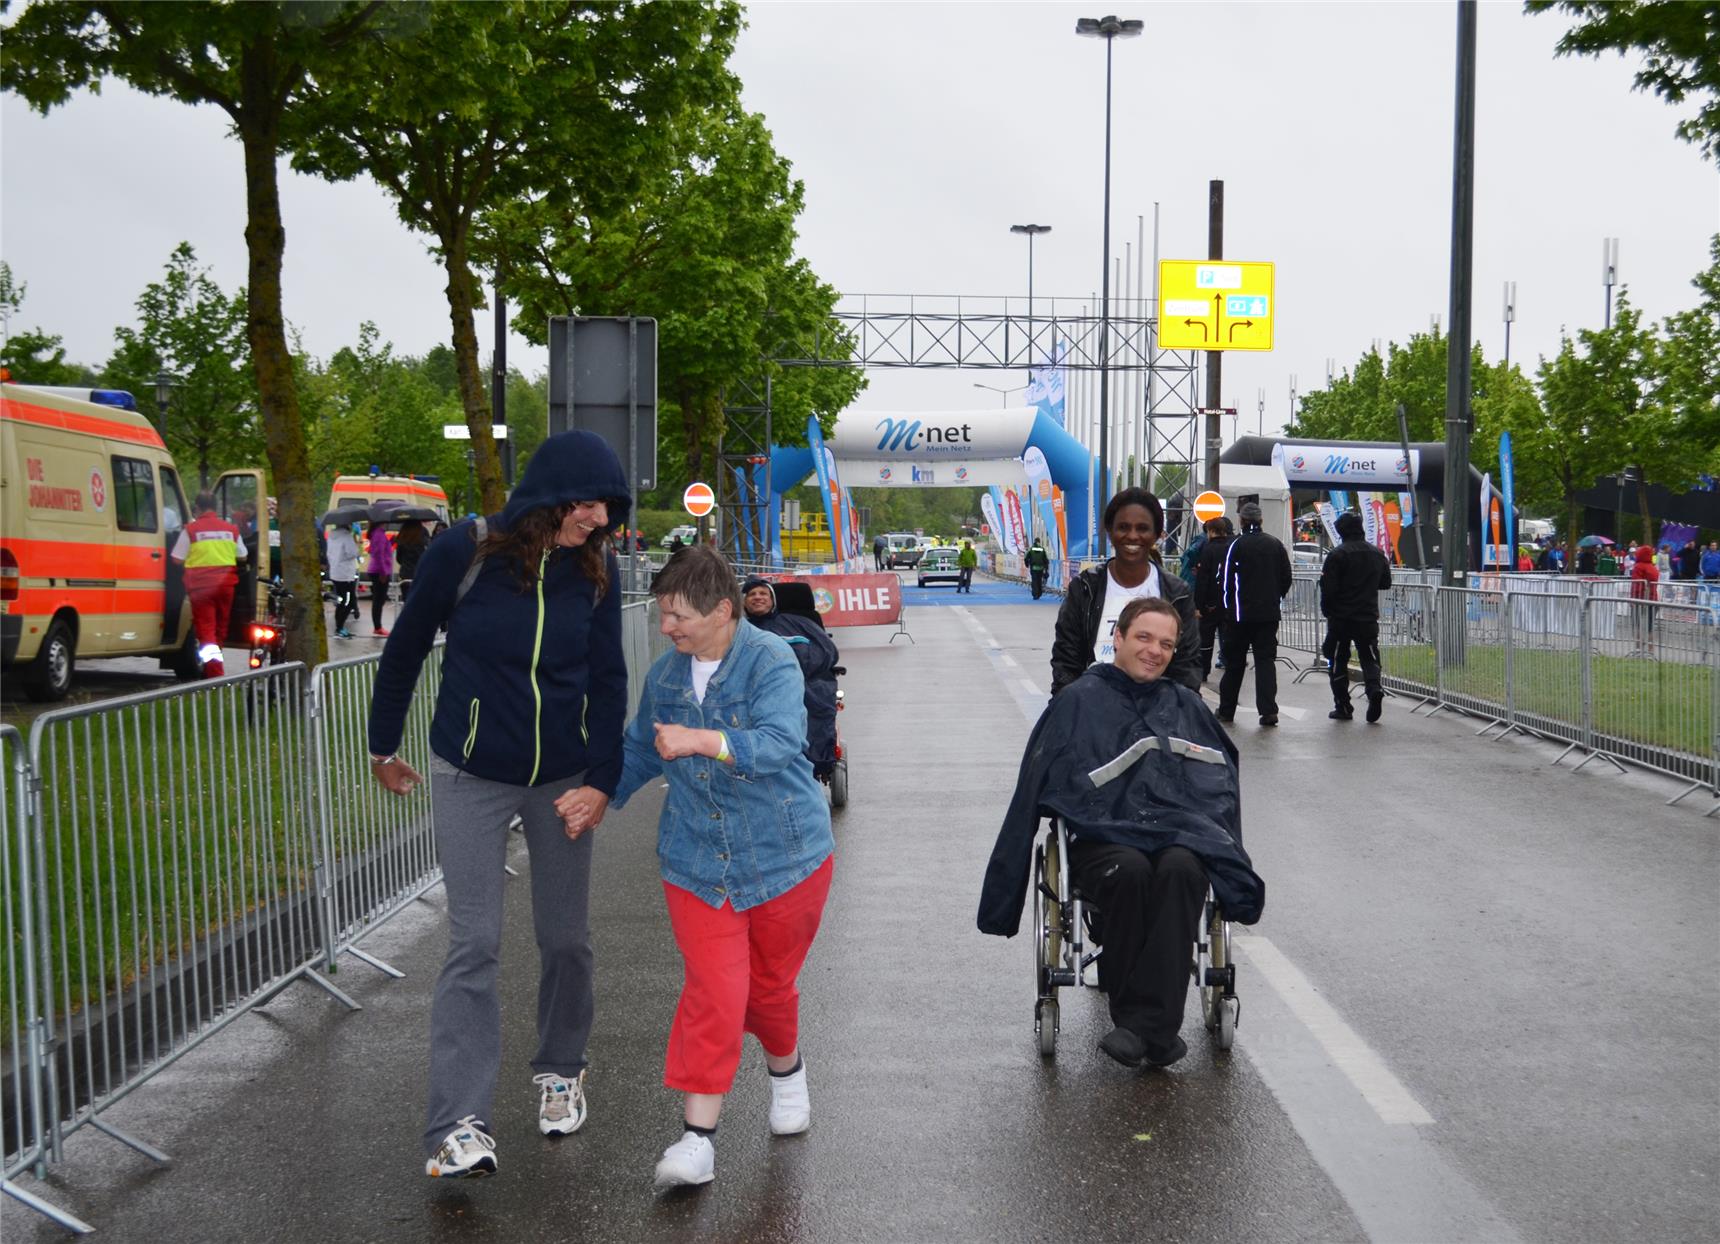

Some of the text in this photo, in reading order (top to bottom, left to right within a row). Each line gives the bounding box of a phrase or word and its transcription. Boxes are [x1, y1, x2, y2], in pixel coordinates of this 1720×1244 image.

[27, 458, 44, 481] DIE
[912, 465, 935, 482] km
[29, 484, 83, 512] JOHANNITER
[838, 588, 891, 611] IHLE
